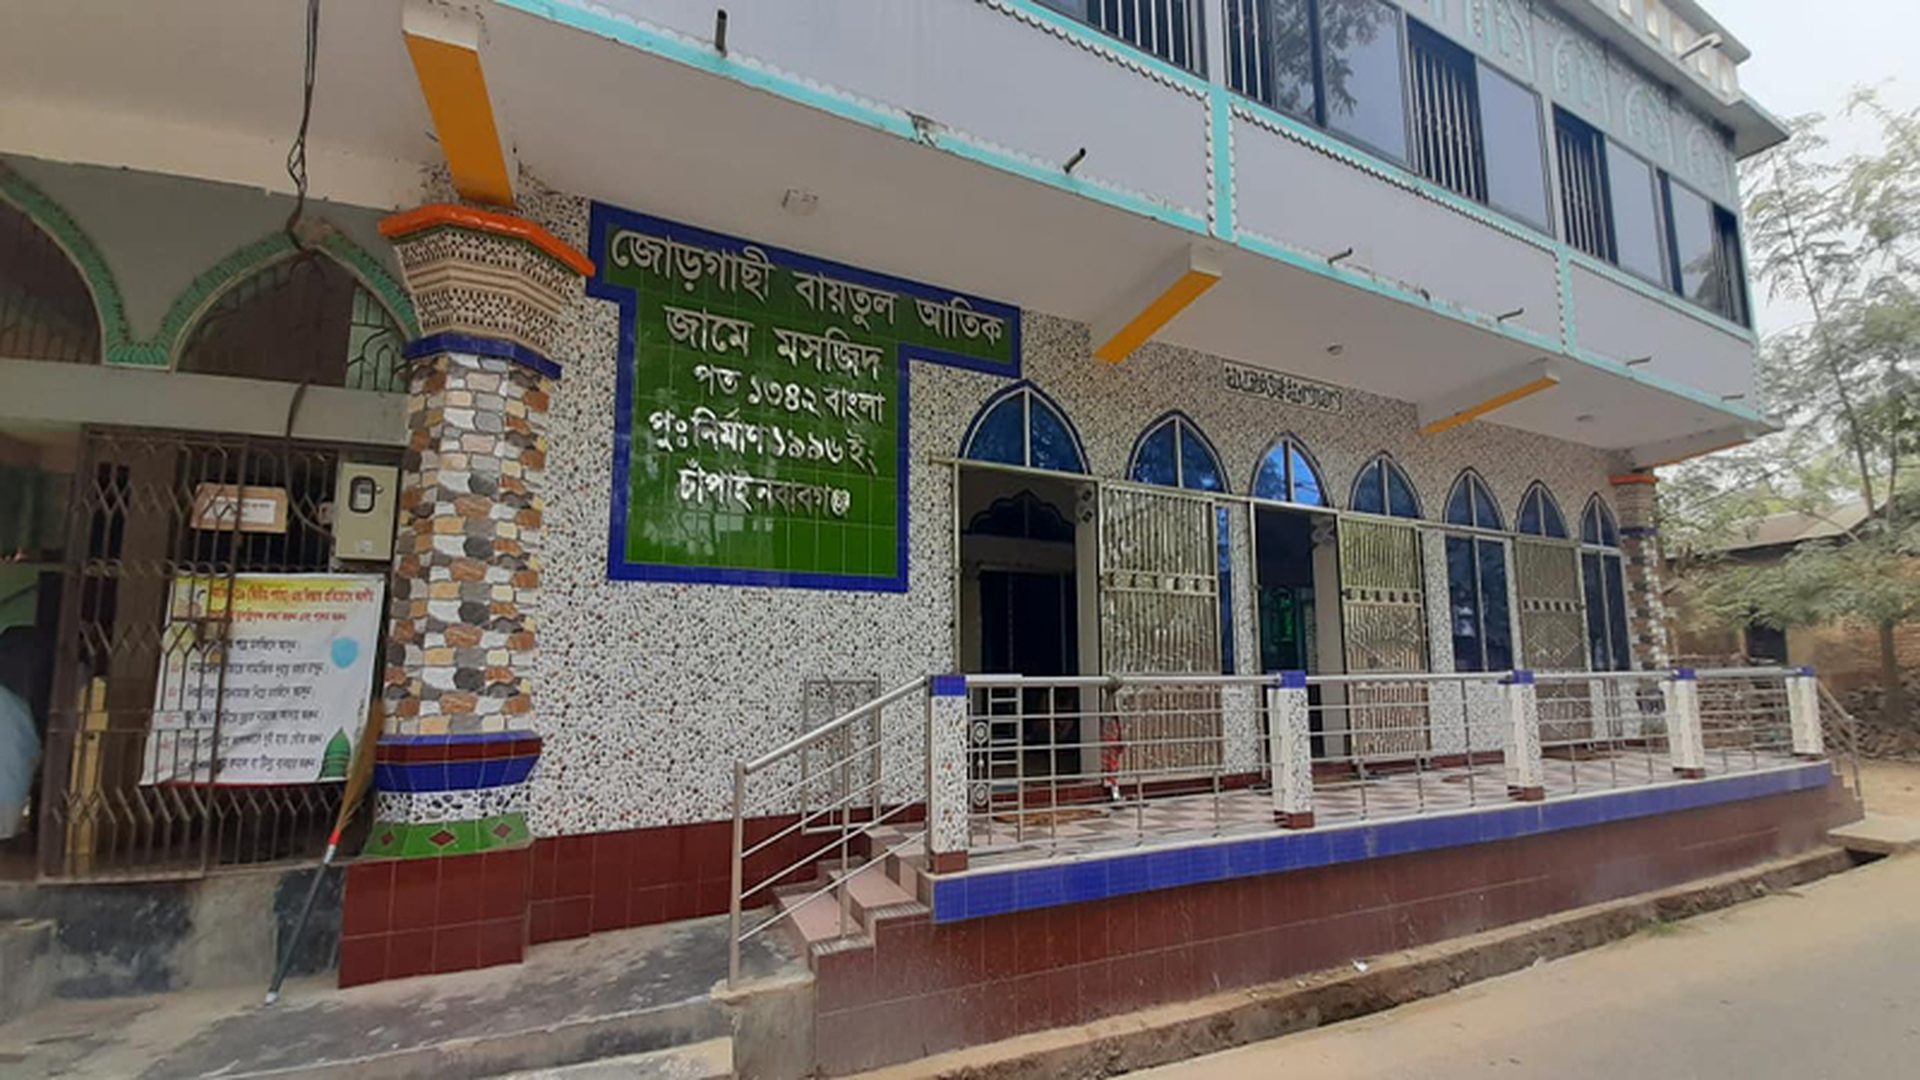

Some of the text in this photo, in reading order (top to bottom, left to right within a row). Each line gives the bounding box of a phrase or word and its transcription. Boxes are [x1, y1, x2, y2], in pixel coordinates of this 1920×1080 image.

[611, 230, 1004, 345] জোড়গাছী বায়তুল আতিক
[664, 306, 883, 380] জামে মসজিদ
[749, 377, 820, 416] ১৩৪২
[824, 386, 886, 421] বাংলা
[773, 427, 843, 464] ১৯৯৬
